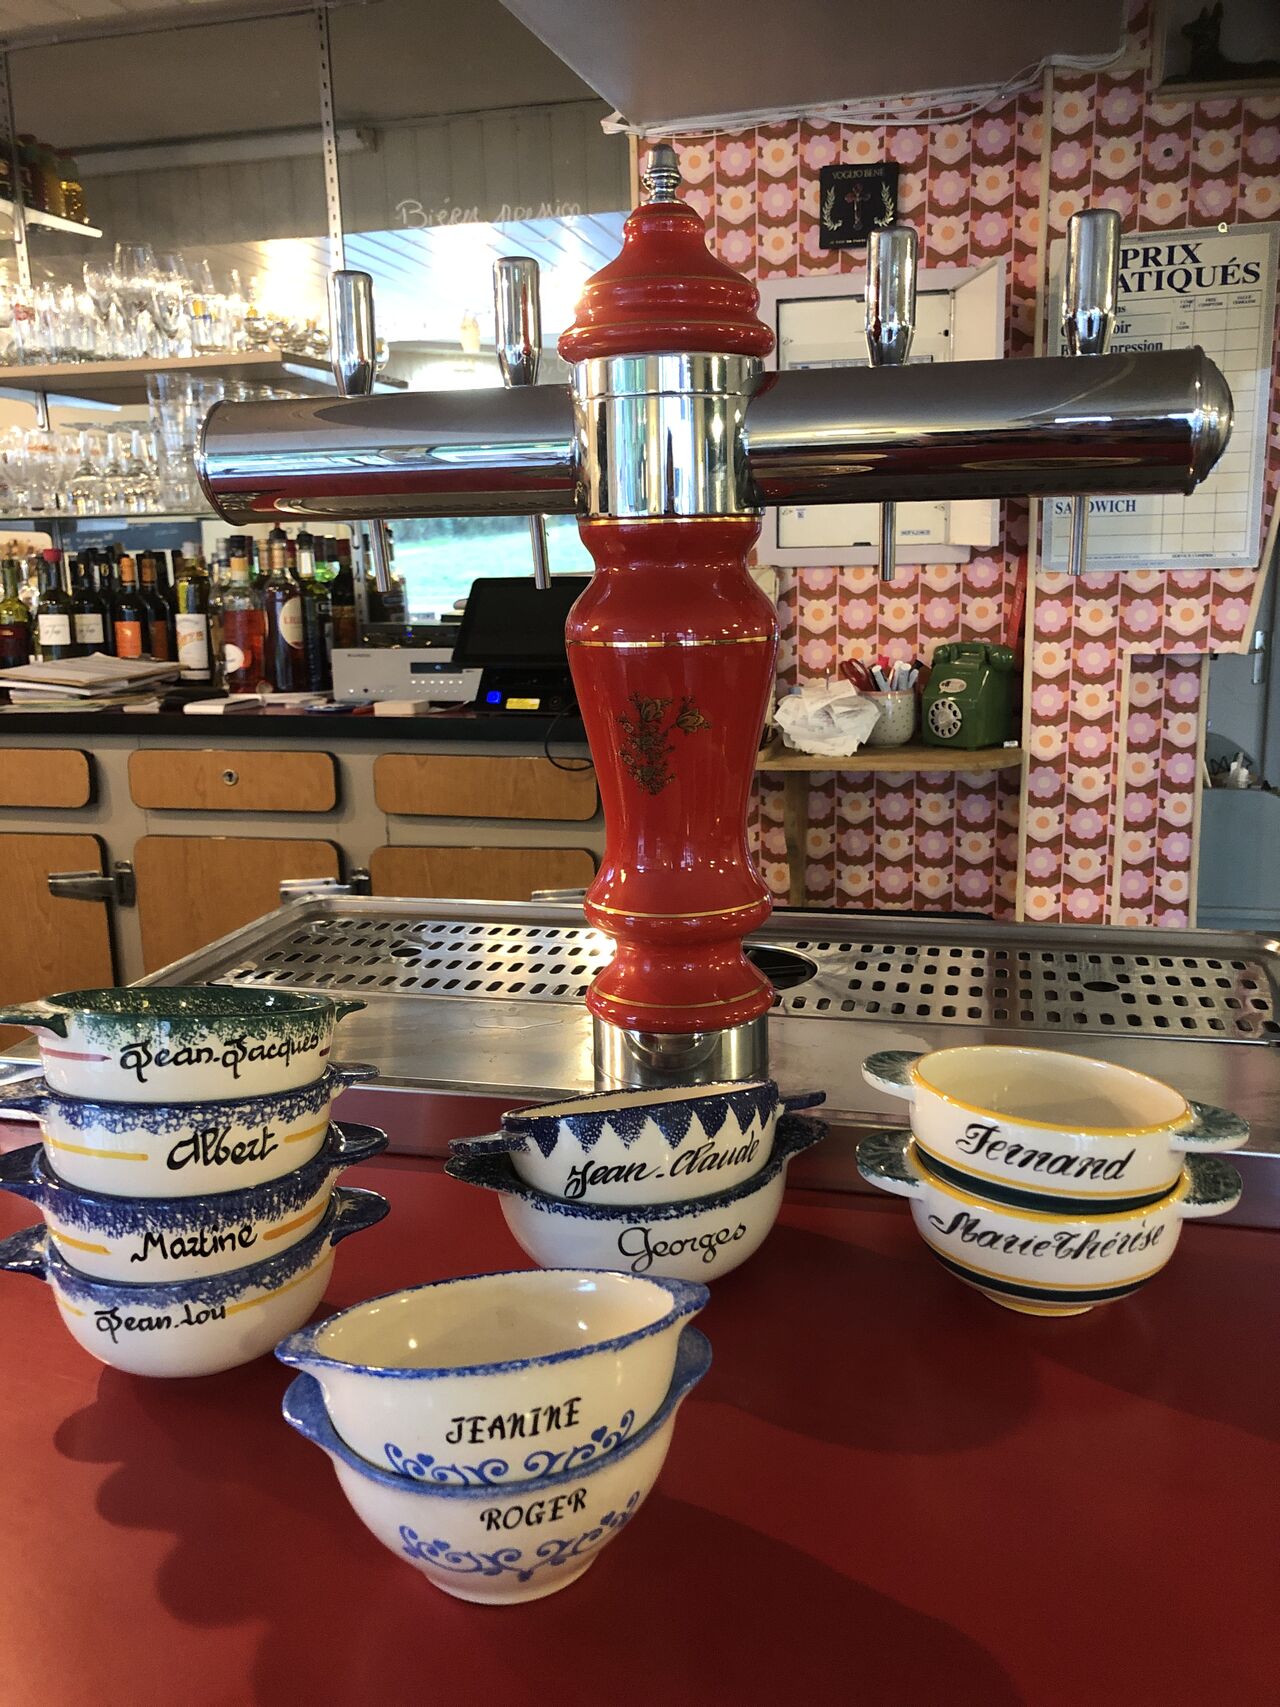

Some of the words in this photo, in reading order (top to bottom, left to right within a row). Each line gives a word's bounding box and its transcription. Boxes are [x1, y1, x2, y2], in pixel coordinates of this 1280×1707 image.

[1117, 257, 1260, 293] ATIQUÉS
[1120, 243, 1202, 269] PRIX
[1055, 499, 1136, 515] SADWICH
[167, 1125, 279, 1170] Albert
[955, 1123, 1136, 1180] Fernand
[130, 1224, 258, 1263] Martine
[617, 1223, 747, 1273] Georges
[445, 1397, 583, 1445] JEANINE
[479, 1488, 588, 1532] ROGER
